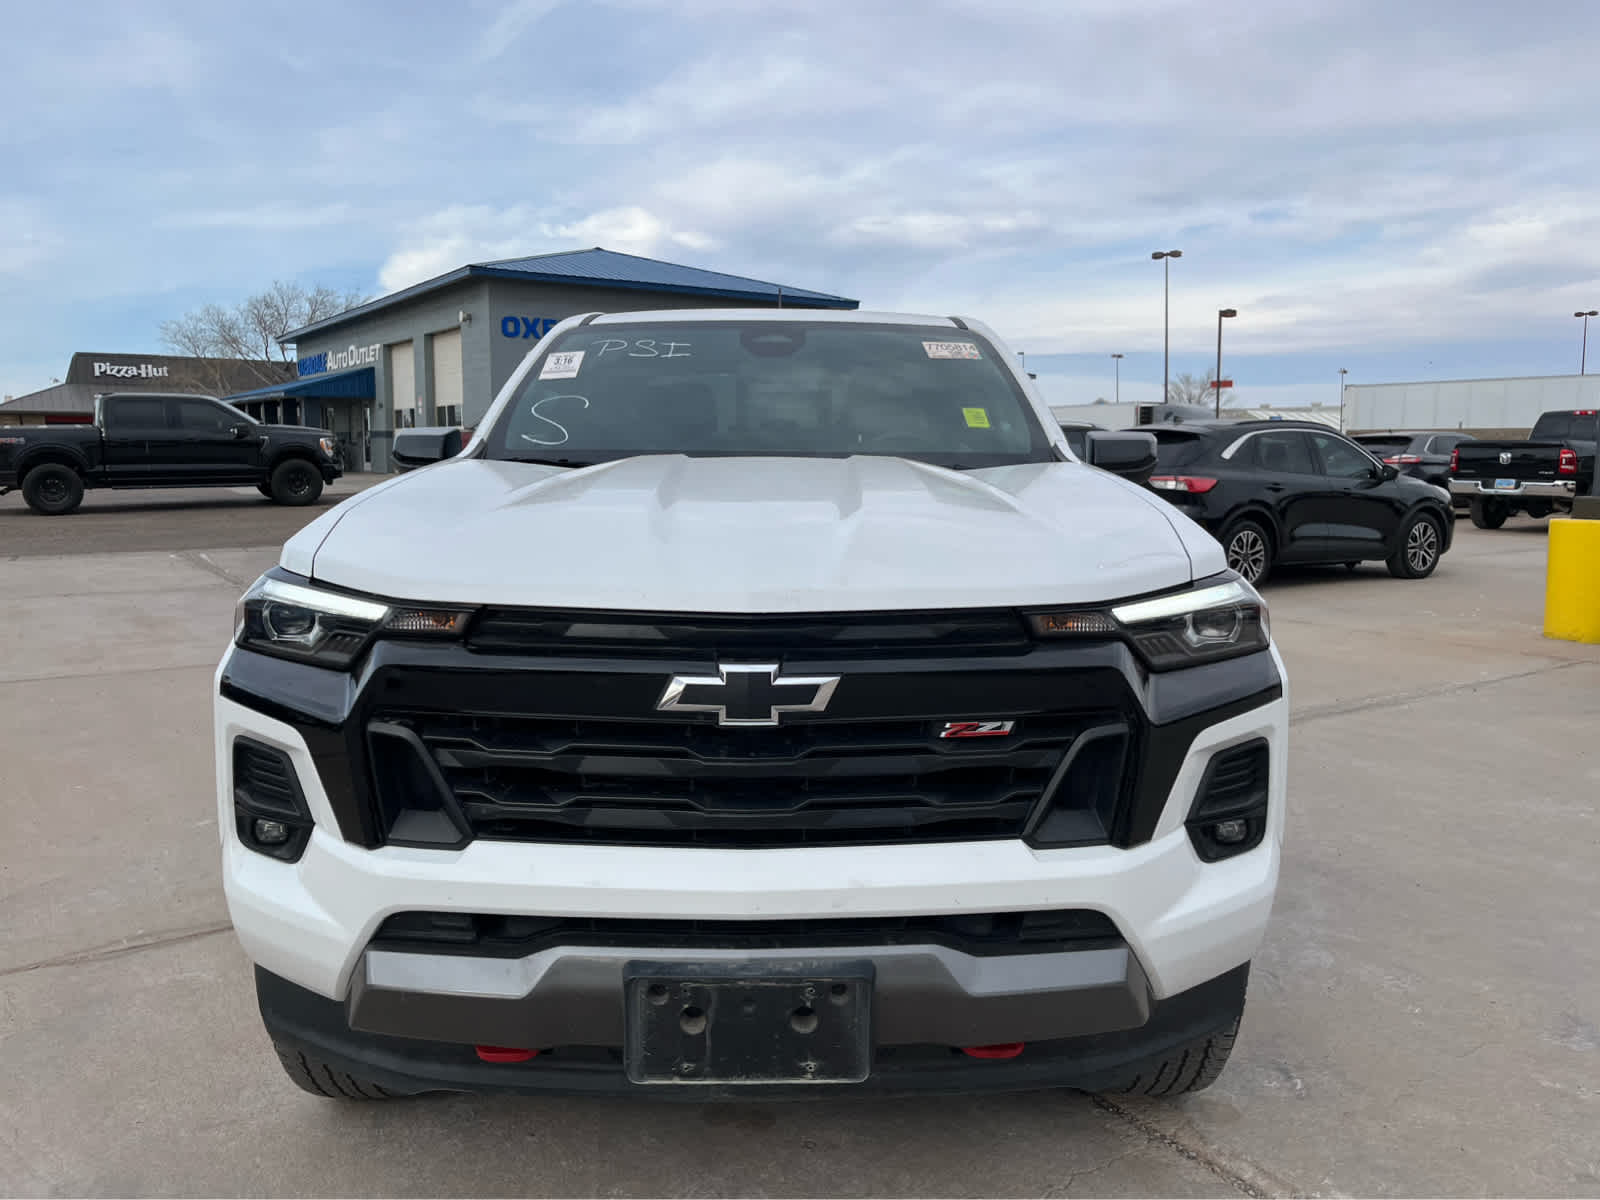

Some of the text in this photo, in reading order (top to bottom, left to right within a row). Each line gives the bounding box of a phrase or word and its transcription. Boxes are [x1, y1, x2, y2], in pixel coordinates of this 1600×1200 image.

[592, 339, 691, 357] PSI
[93, 362, 137, 377] Pizza
[521, 394, 590, 445] S
